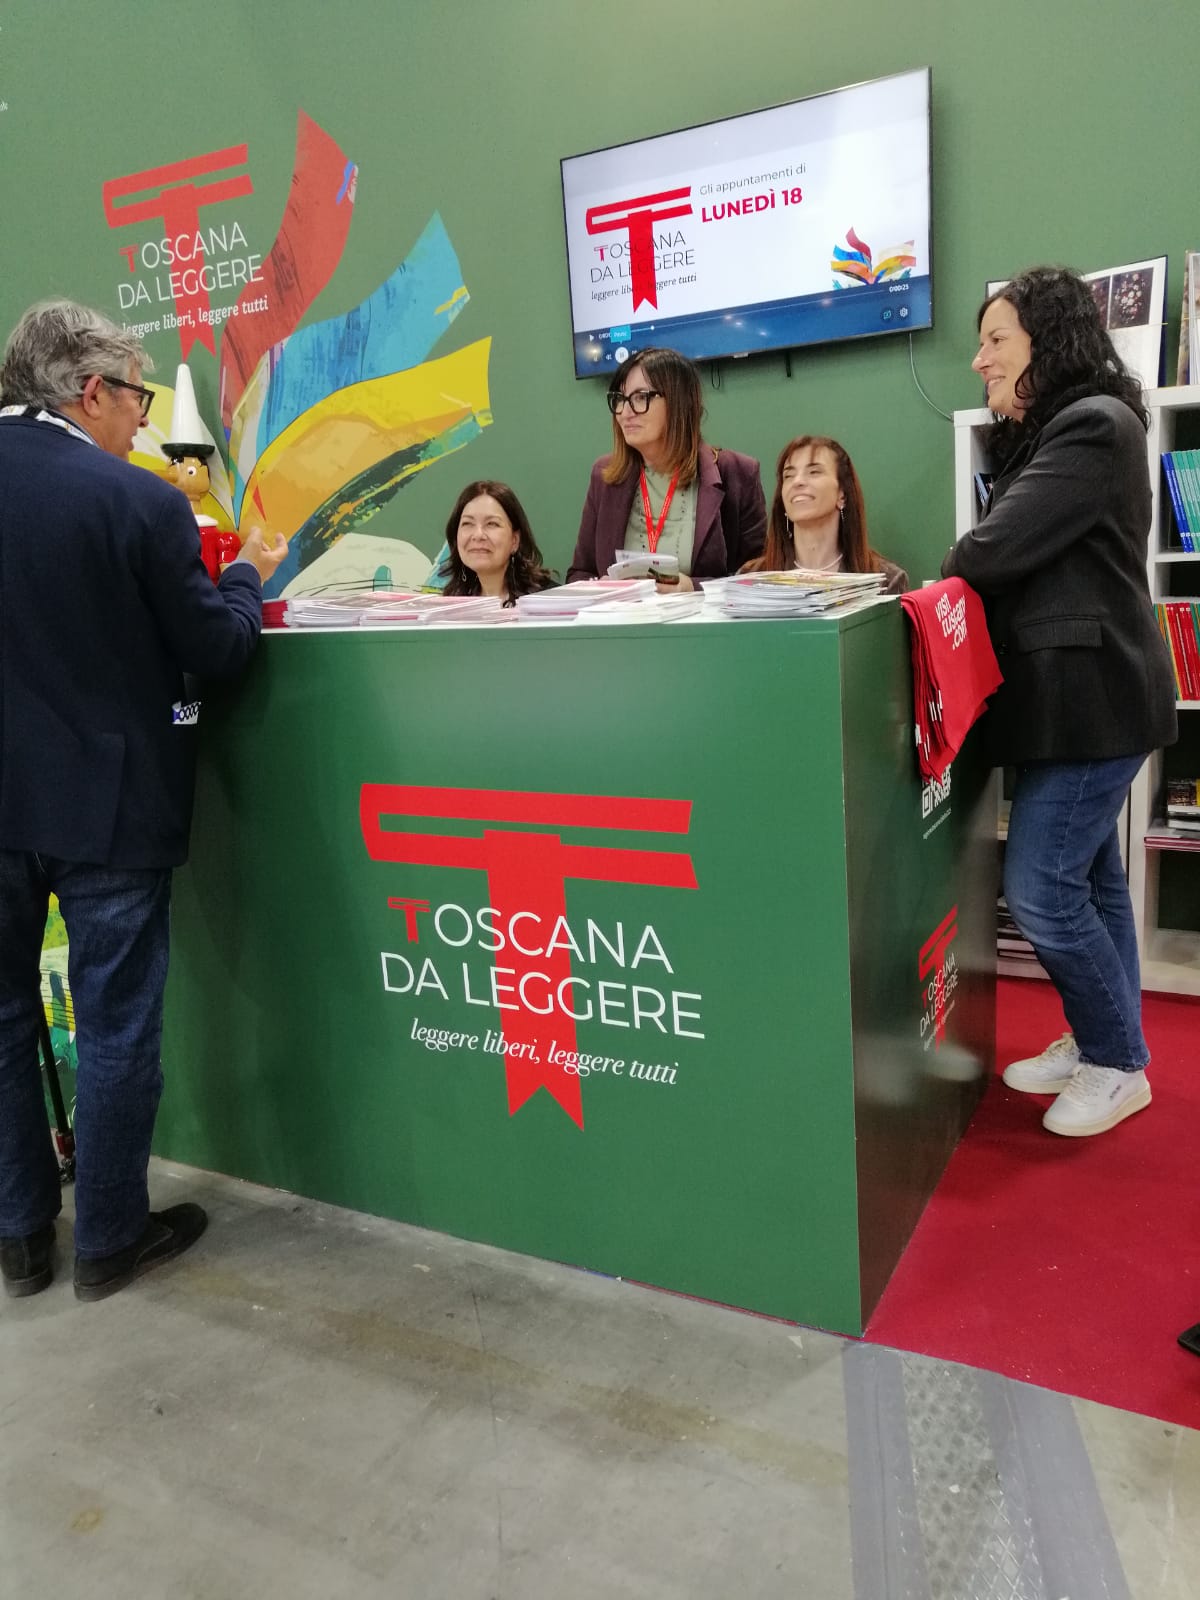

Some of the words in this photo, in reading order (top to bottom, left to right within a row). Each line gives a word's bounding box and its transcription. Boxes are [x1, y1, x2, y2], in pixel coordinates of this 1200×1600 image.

[700, 184, 713, 196] Gli
[716, 165, 793, 193] appuntamenti
[795, 162, 806, 175] di
[701, 188, 776, 223] LUNEDÌ
[782, 187, 803, 206] 18
[118, 222, 248, 273] TOSCANA
[594, 230, 686, 262] TOSANA
[118, 280, 152, 309] DA
[156, 254, 264, 302] LEGGERE
[590, 265, 614, 283] DA
[618, 248, 696, 278] LGERE
[678, 272, 697, 285] tutti
[163, 310, 195, 329] liberi,
[198, 304, 239, 325] leggere
[242, 295, 269, 314] tutti
[387, 896, 674, 975] TOSCANA
[380, 951, 449, 1001] DA
[462, 962, 706, 1040] LEGGERE
[920, 1010, 931, 1038] DA
[410, 1018, 479, 1052] leggere
[482, 1029, 541, 1064] liberi,
[546, 1040, 625, 1077] leggere
[629, 1062, 679, 1085] tutti
